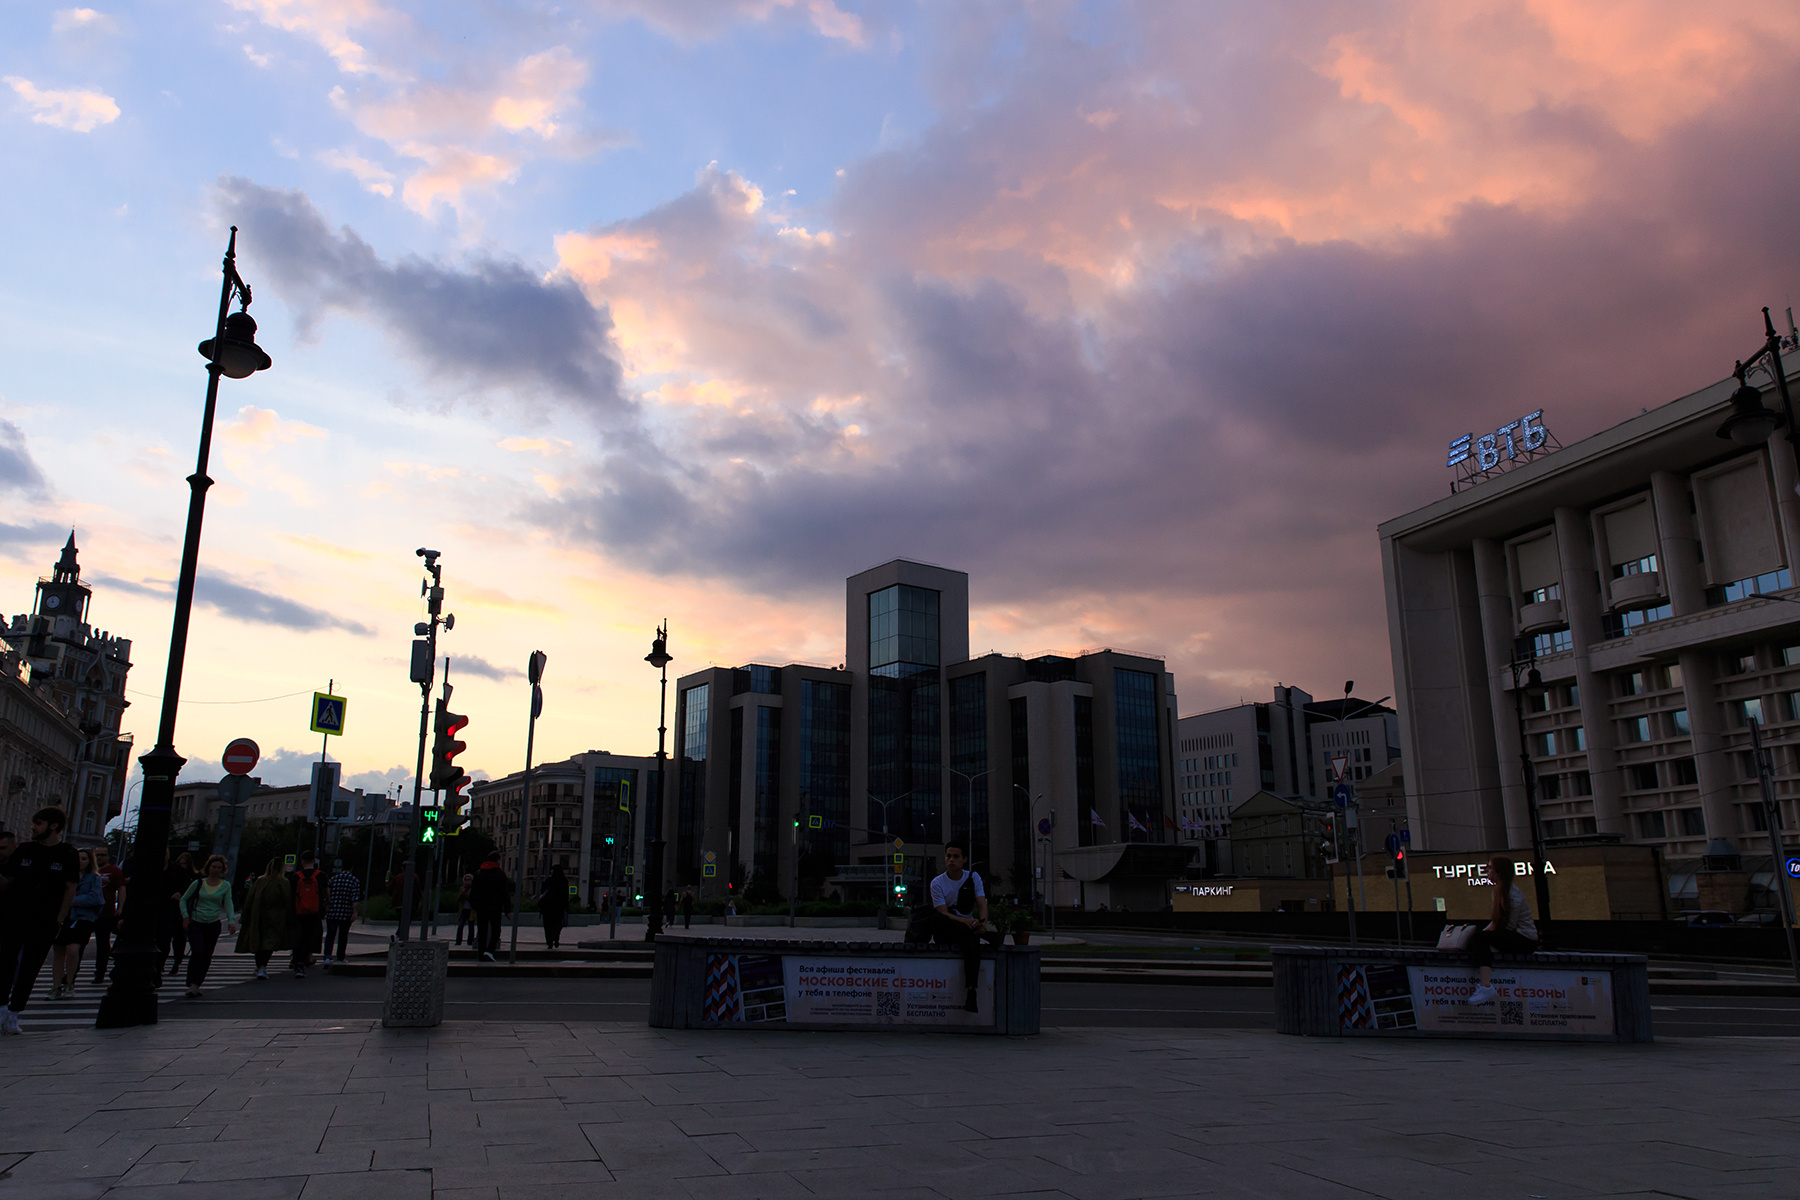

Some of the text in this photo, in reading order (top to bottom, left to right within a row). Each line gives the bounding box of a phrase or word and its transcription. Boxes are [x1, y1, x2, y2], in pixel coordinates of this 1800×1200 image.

[1477, 409, 1548, 471] ВТБ
[424, 810, 438, 821] 44
[1432, 861, 1556, 878] ТУРГЕВКА
[1192, 886, 1234, 896] ПАРКИНГ
[799, 965, 896, 975] Вся афиша фестивалей
[799, 976, 947, 989] МОСКОВСКИЕ СЕЗОНЫ
[1424, 975, 1438, 983] Вся
[1439, 975, 1466, 984] афиша
[798, 990, 804, 998] у
[805, 989, 823, 997] тебя
[833, 990, 872, 999] телефоне
[1424, 986, 1566, 998] МОСКОВИЕ СЕЗОНЫ
